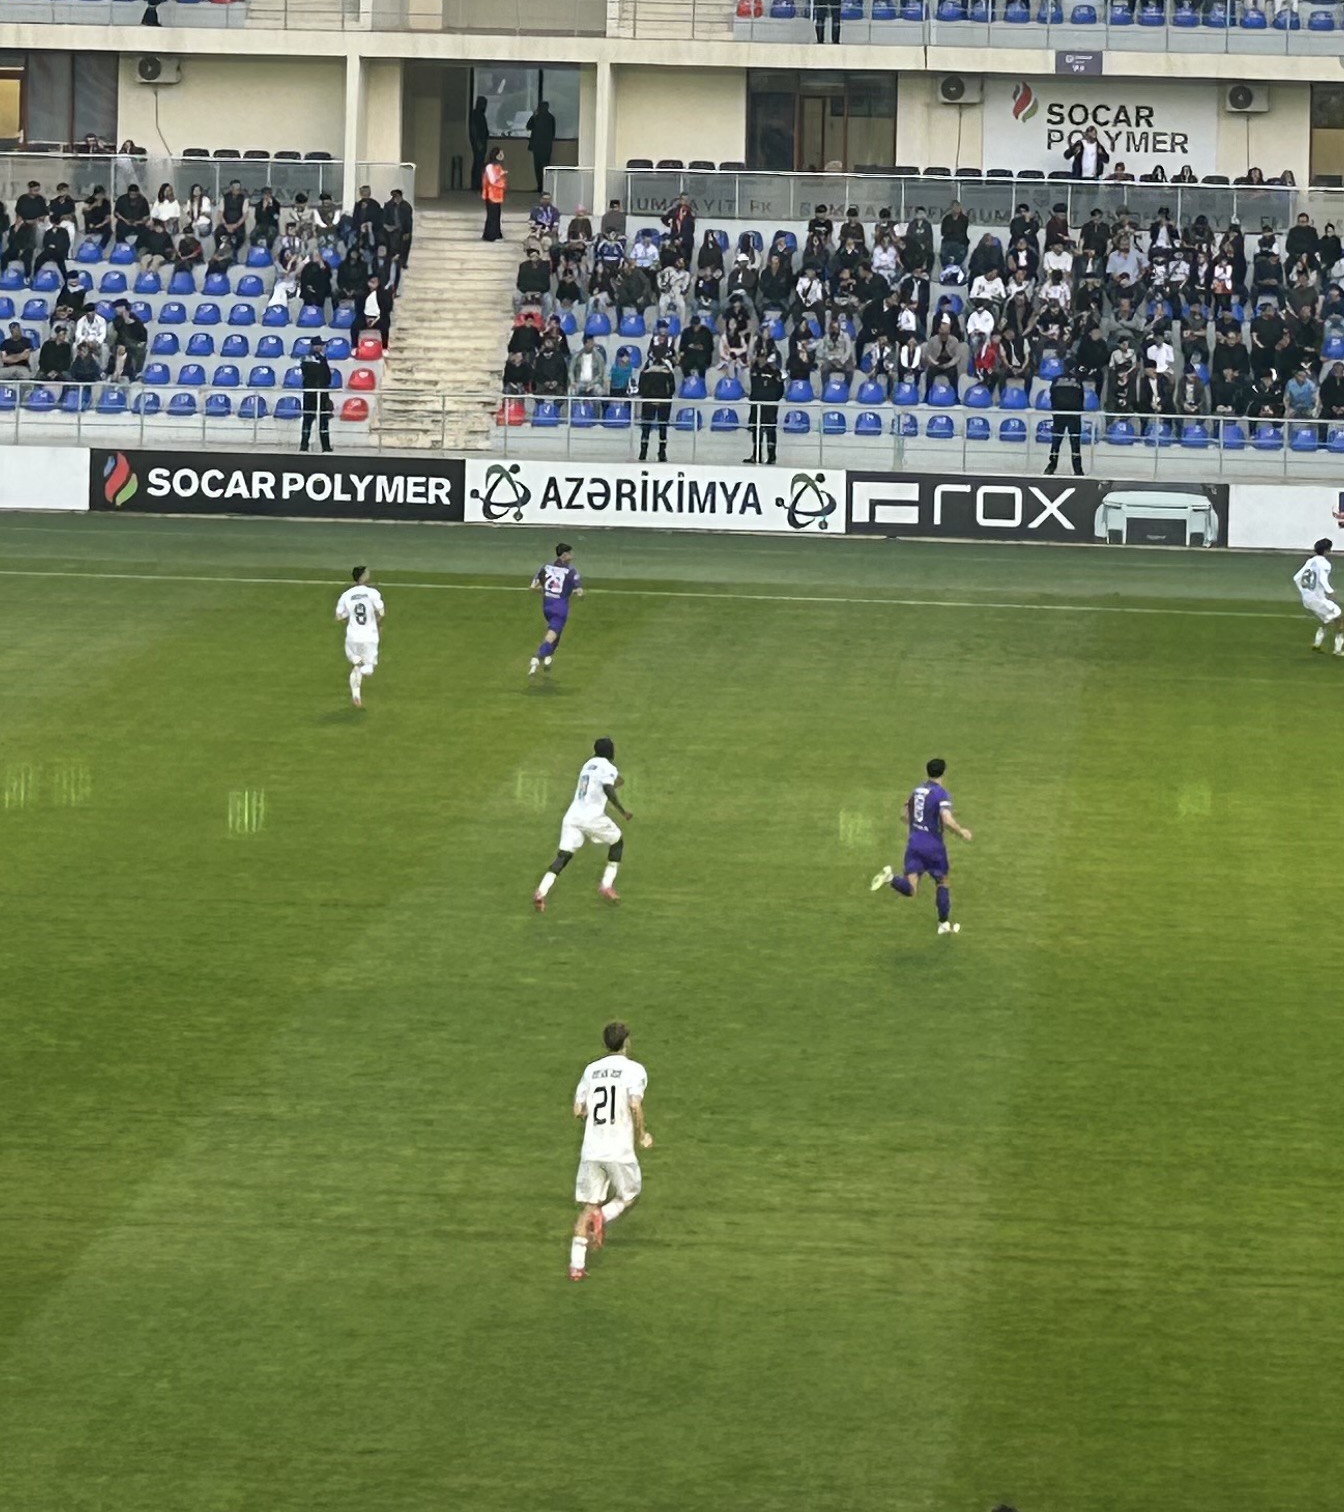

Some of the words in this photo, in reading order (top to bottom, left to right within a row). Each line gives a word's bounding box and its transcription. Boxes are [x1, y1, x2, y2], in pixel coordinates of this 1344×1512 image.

[1046, 102, 1155, 128] SOCAR
[1046, 129, 1189, 154] POYMER
[146, 467, 276, 500] SOCAR
[281, 472, 452, 506] POLYMER
[540, 470, 763, 516] AZƏRİKİMYA
[593, 1085, 617, 1126] 21
